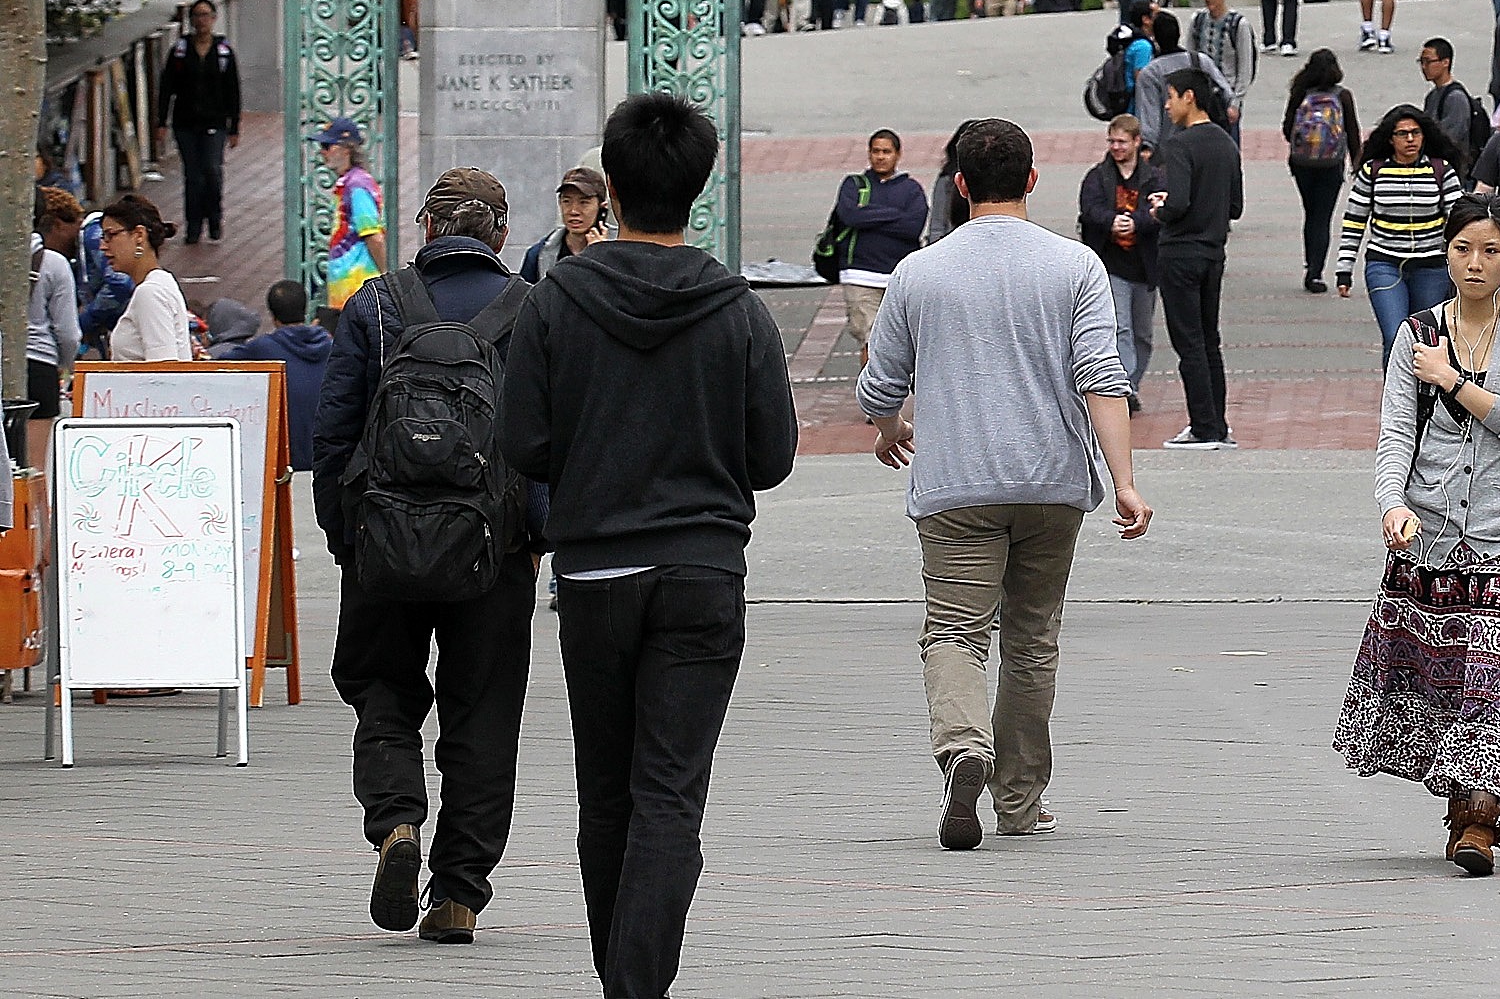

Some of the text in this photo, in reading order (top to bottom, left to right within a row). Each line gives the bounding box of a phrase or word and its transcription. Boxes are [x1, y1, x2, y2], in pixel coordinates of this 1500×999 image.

[437, 74, 481, 91] JANE
[509, 74, 574, 91] SATHER
[93, 388, 181, 418] Muslim
[70, 435, 216, 498] Circle
[161, 543, 232, 561] MONAY
